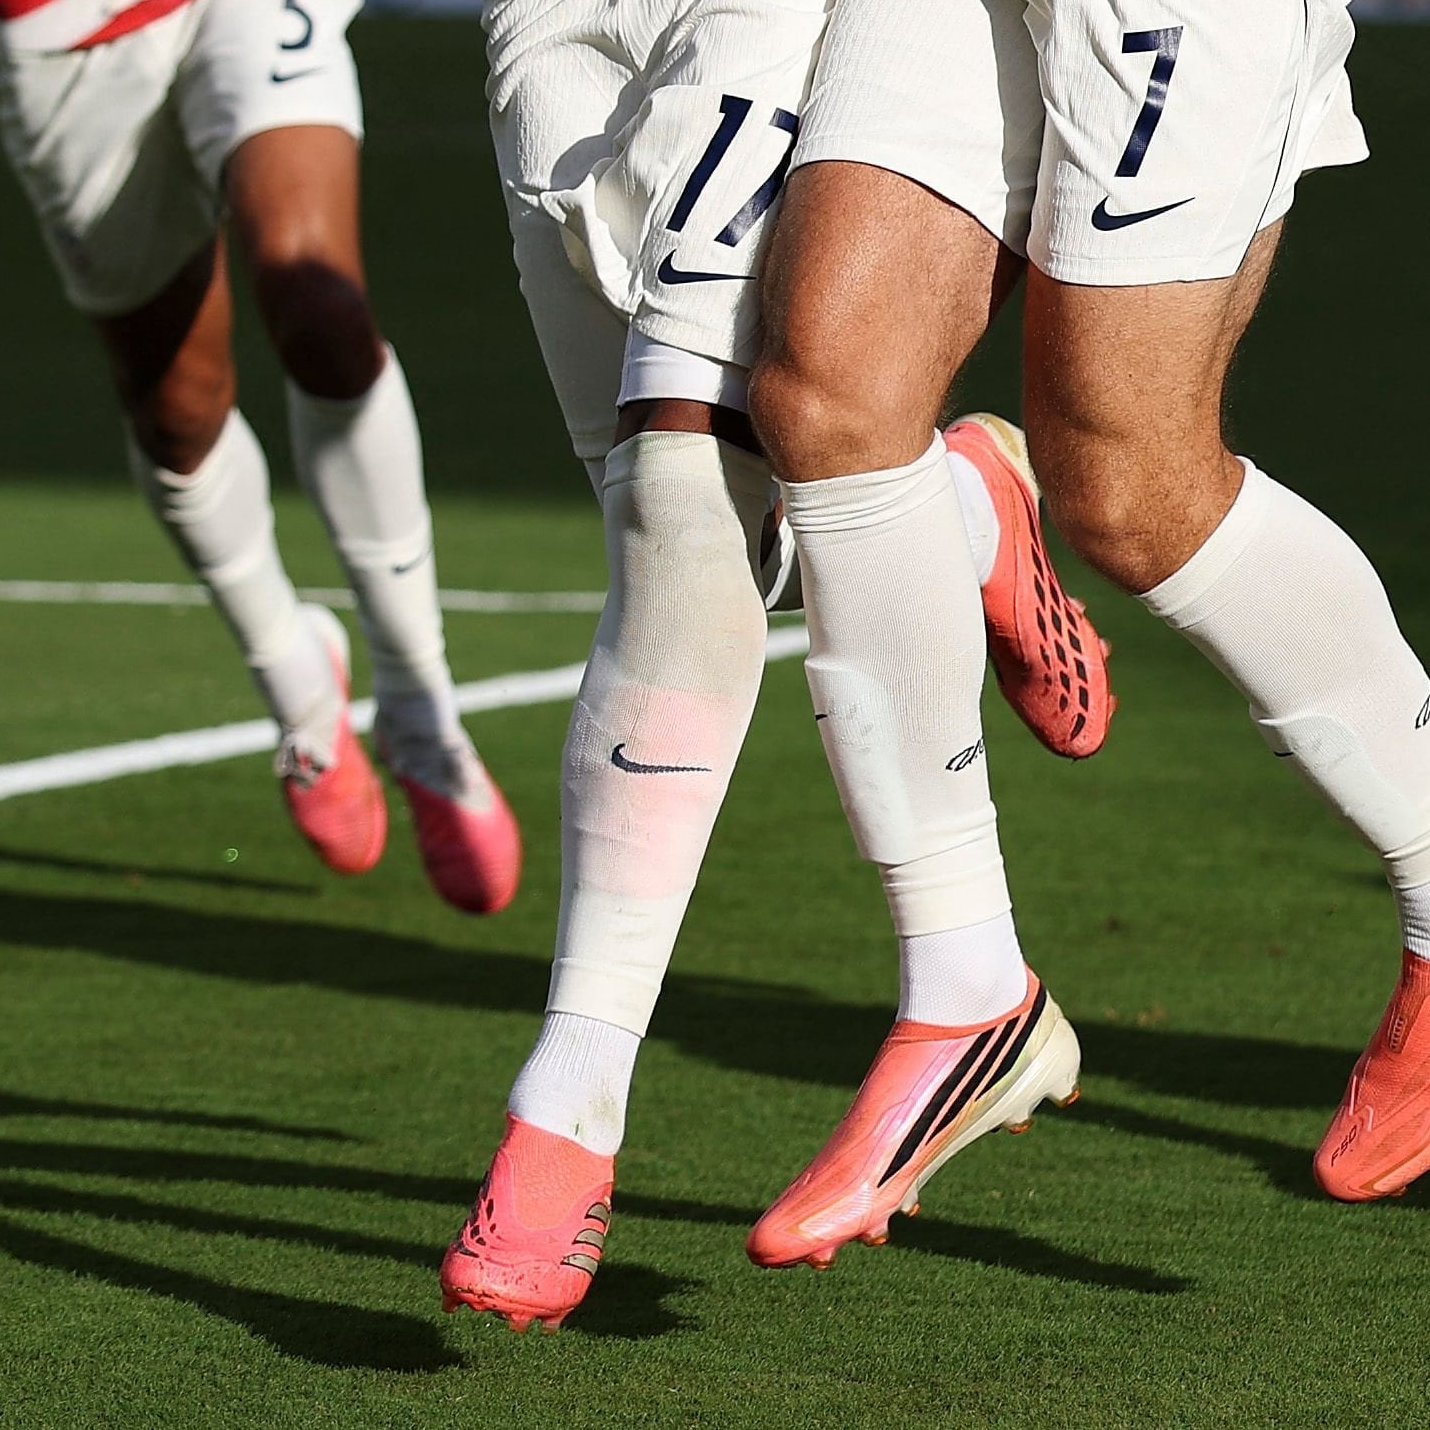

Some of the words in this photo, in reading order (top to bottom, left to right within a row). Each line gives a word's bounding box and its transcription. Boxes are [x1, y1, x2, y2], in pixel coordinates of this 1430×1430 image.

[665, 94, 801, 248] 17
[1114, 26, 1184, 177] 7
[1330, 1124, 1357, 1168] F50
